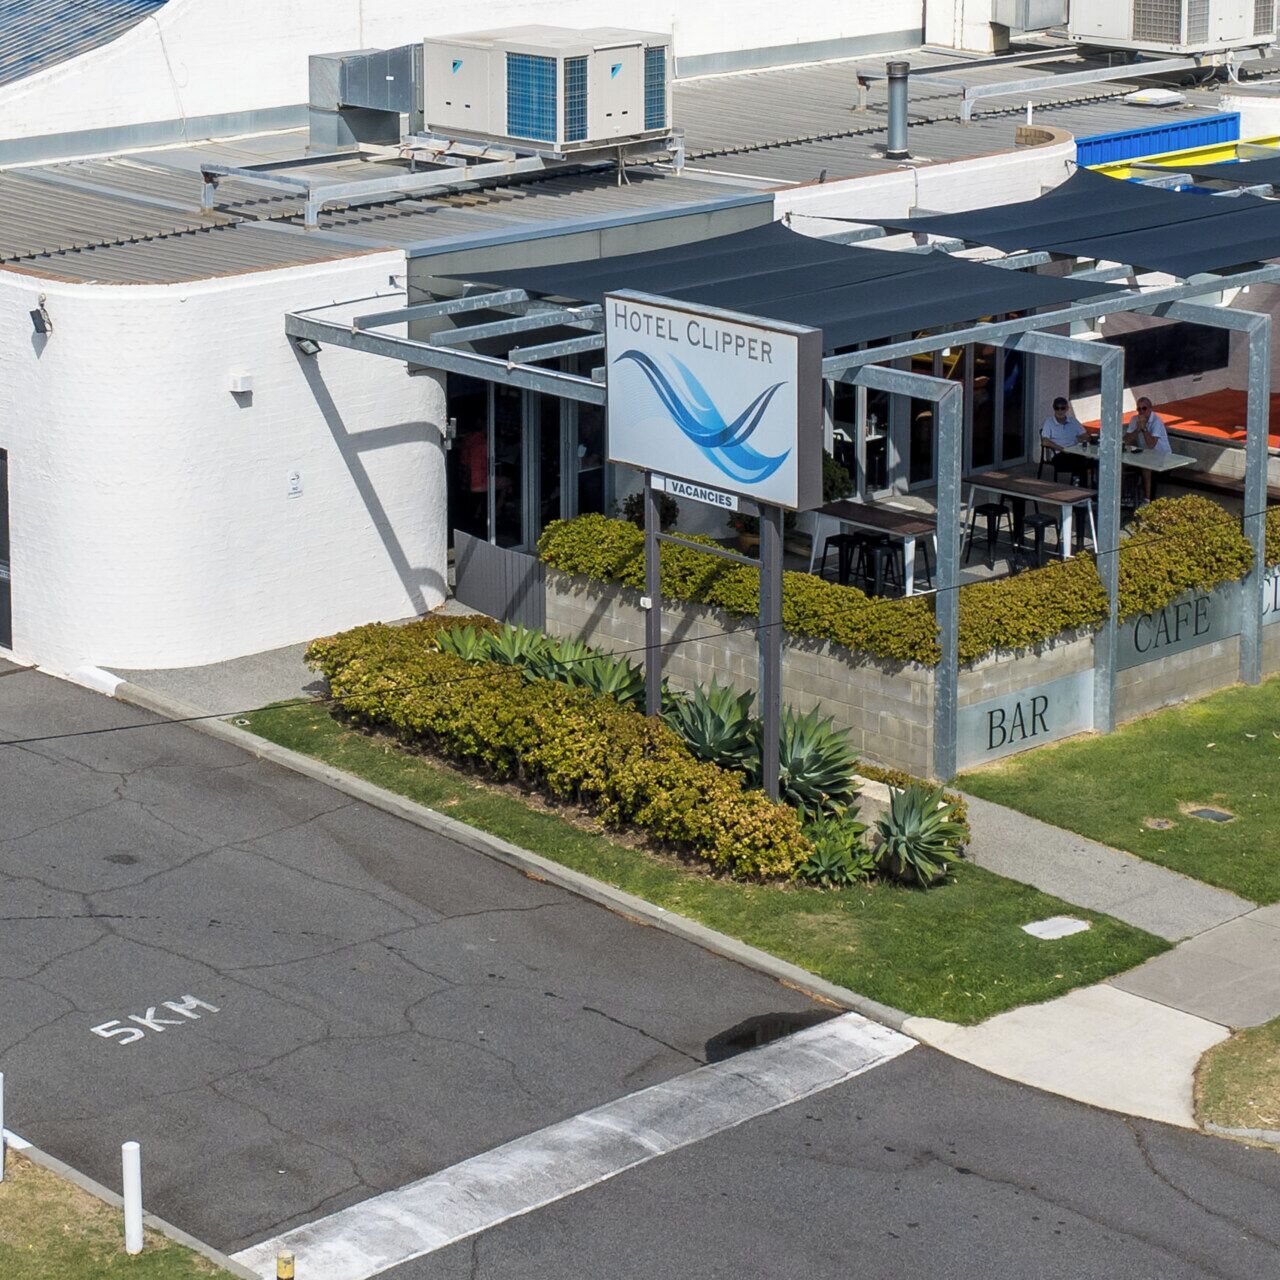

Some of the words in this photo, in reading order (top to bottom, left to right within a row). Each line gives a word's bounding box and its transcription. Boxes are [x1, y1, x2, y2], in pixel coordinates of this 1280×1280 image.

[614, 303, 679, 342] HOTEL
[686, 320, 772, 364] CLIPPER
[671, 481, 732, 507] VACANCIES
[1134, 595, 1212, 653] CAFE
[986, 695, 1050, 751] BAR
[90, 994, 220, 1045] 5KM
